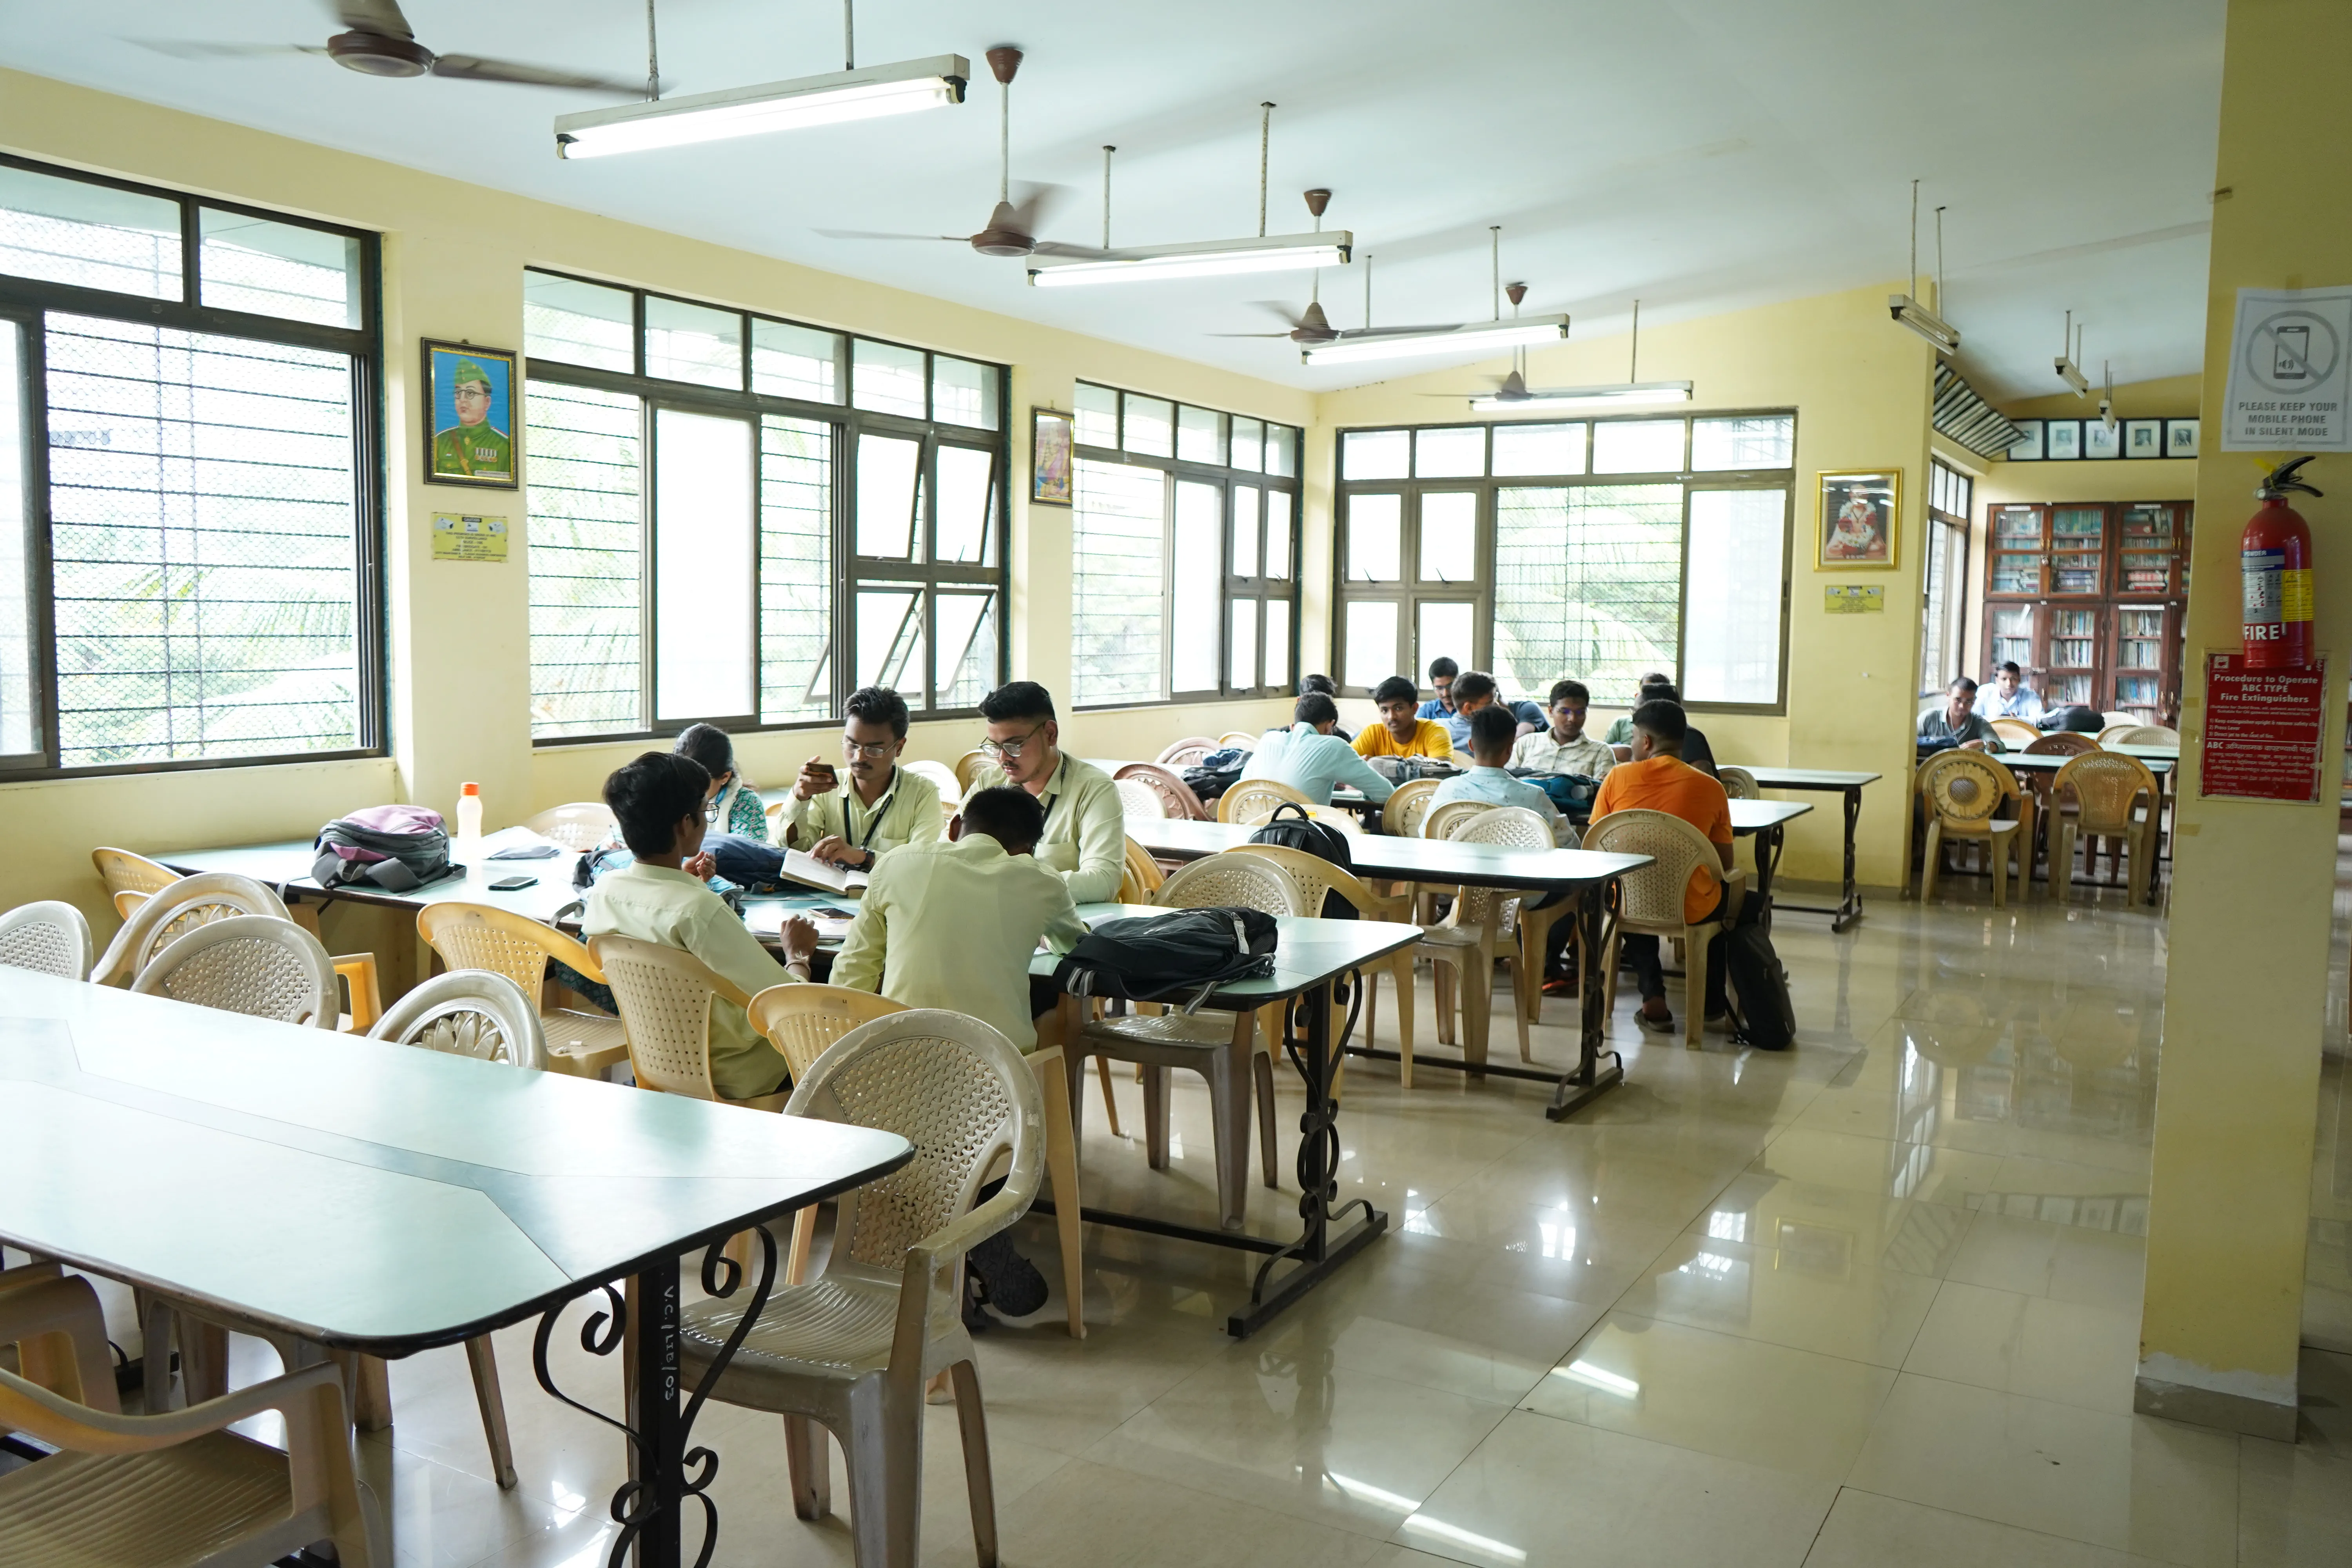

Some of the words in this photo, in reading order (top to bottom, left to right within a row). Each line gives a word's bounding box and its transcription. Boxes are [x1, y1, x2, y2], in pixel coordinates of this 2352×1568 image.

[2239, 402, 2276, 411] PLEASE
[2280, 402, 2305, 411] KEEP
[2310, 402, 2337, 411] YOUR
[2291, 415, 2326, 424] PHONE
[2298, 428, 2328, 436] MODE
[2214, 674, 2263, 682] Procedure
[2278, 675, 2318, 684] Operate
[2242, 694, 2309, 703] Extinguishers
